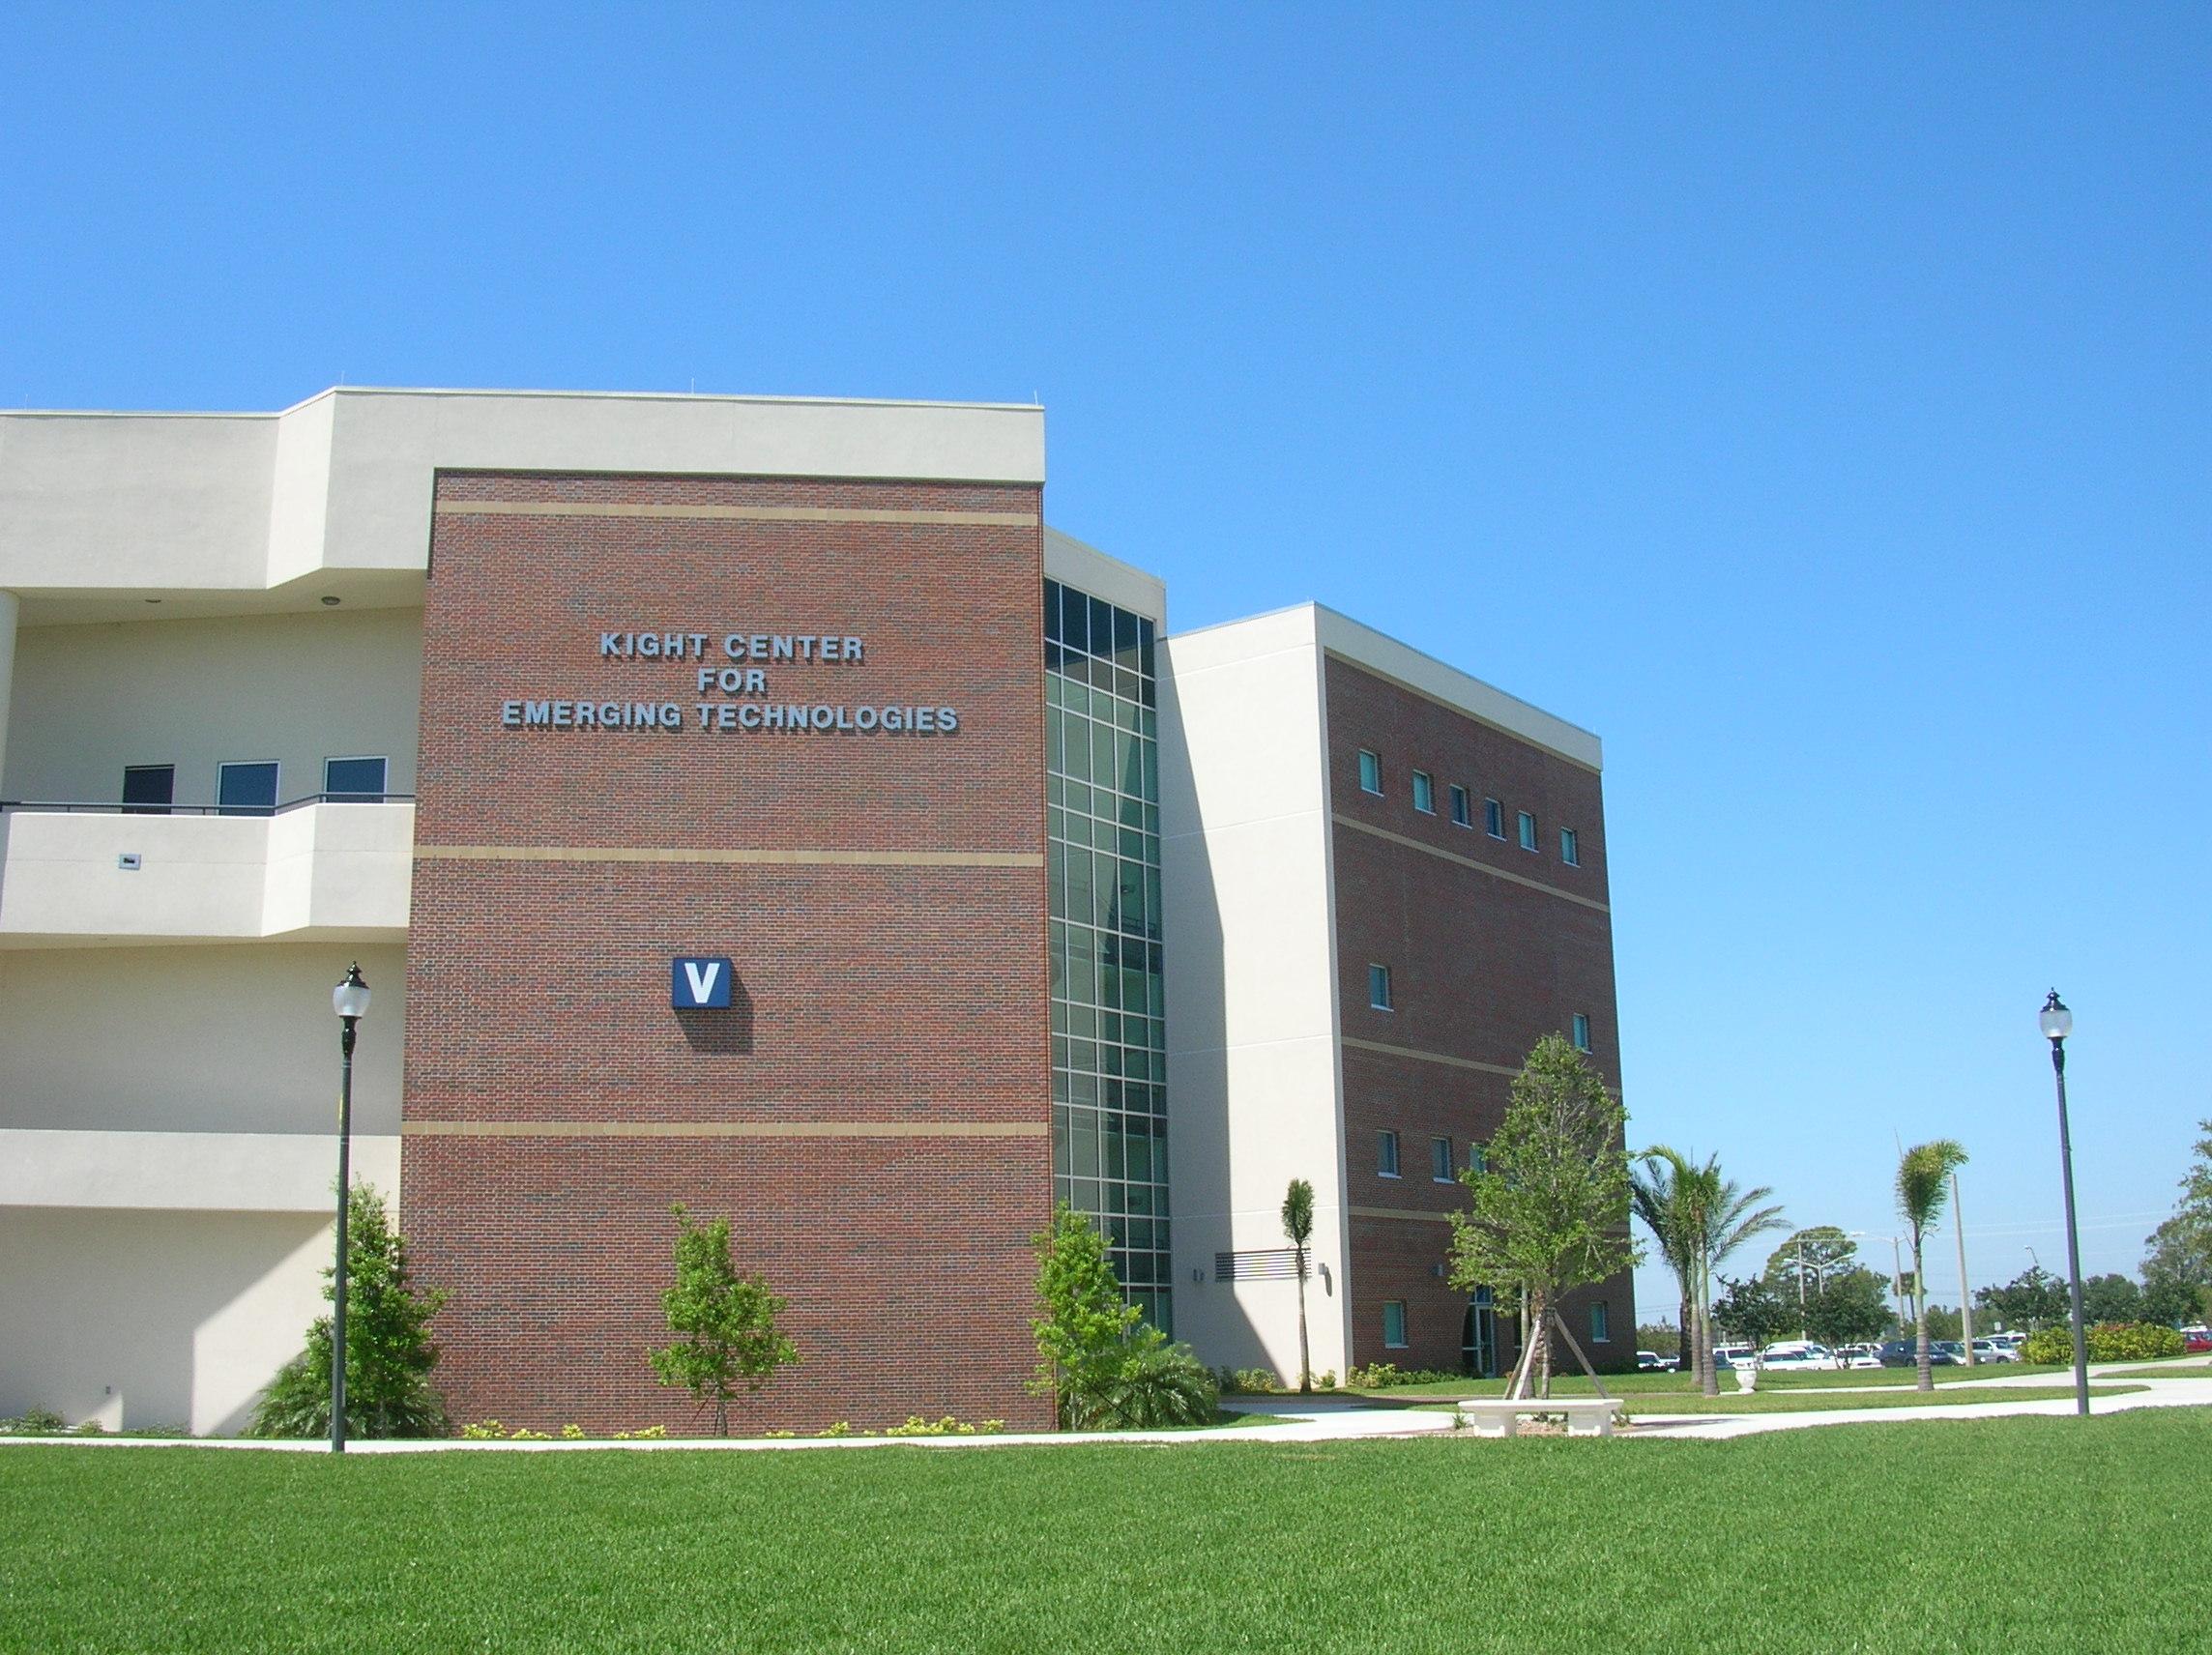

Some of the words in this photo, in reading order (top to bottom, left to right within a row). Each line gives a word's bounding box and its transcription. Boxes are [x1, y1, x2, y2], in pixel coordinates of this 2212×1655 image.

[600, 632, 708, 657] KIGHT
[724, 633, 864, 660] CENTER
[697, 668, 768, 693] FOR
[502, 700, 681, 727] EMERGING
[695, 703, 958, 732] TECHNOLOGIES
[684, 962, 721, 1003] V
